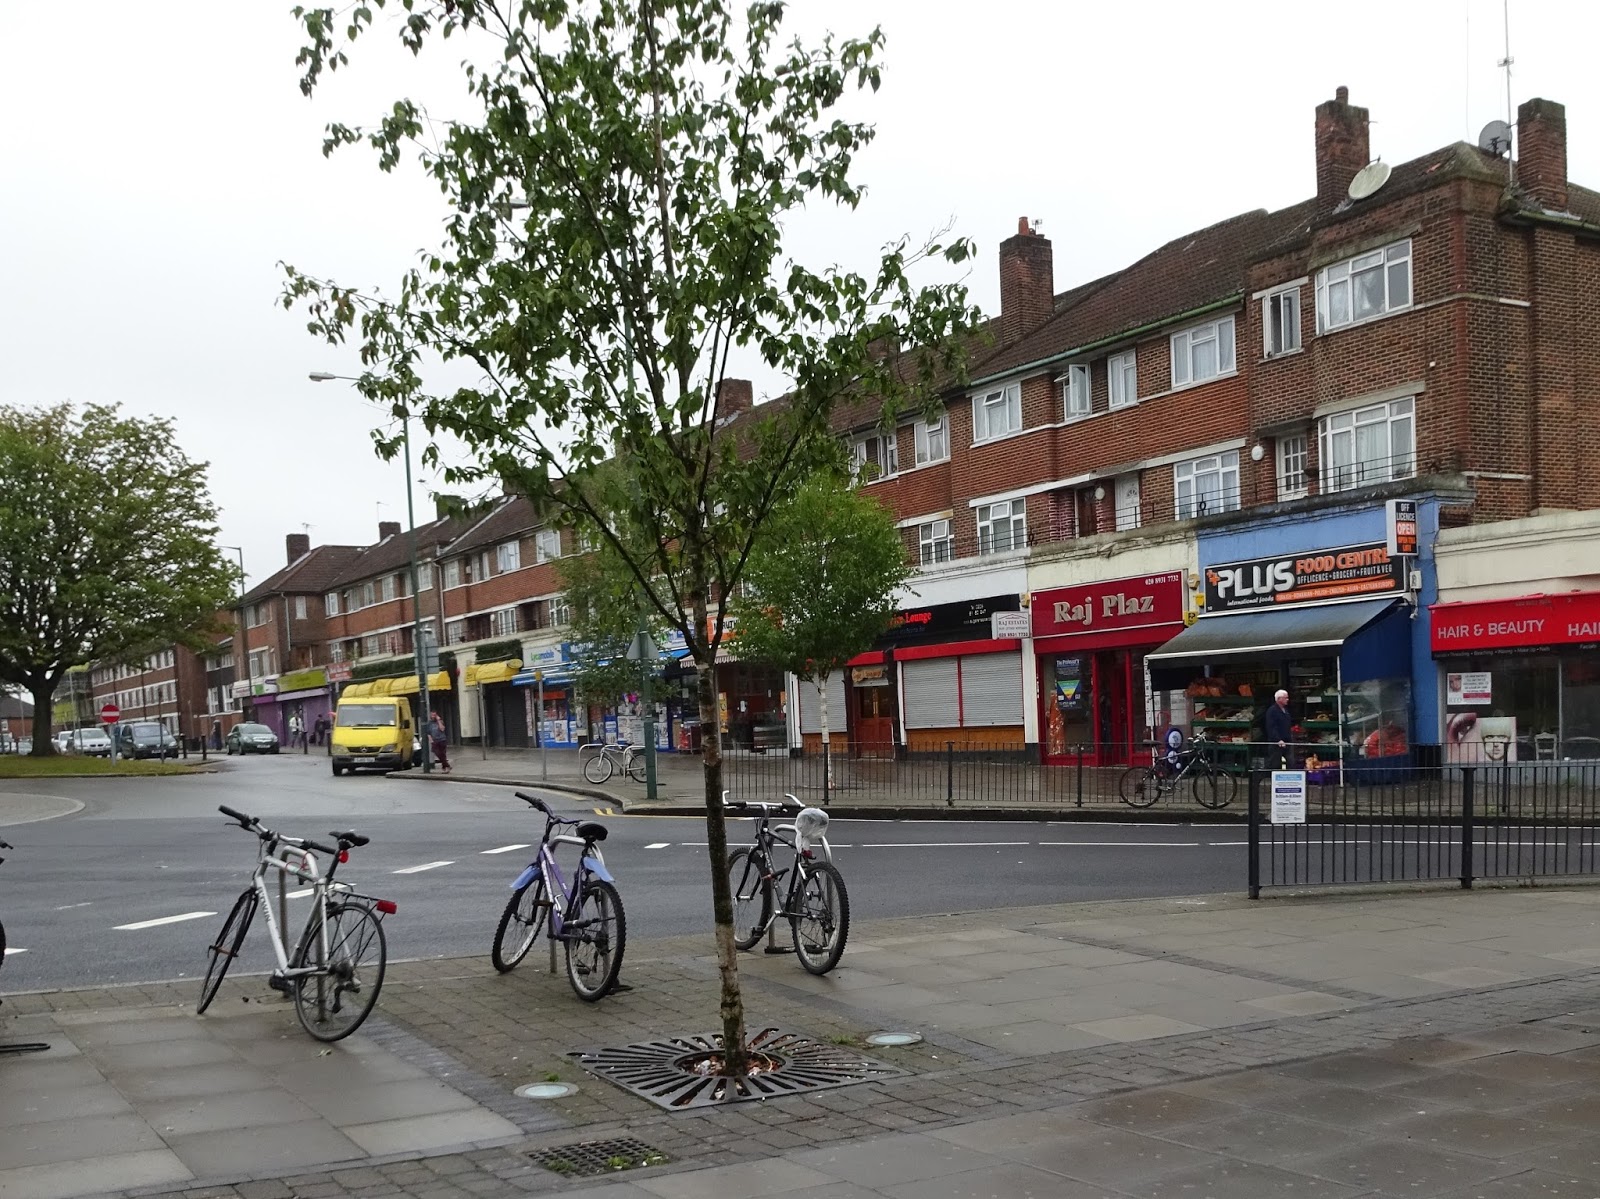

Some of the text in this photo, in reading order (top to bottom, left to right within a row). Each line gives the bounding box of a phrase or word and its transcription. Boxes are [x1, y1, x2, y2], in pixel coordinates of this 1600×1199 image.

[1400, 503, 1410, 512] OFF
[1396, 512, 1415, 521] LICENCE
[1397, 522, 1415, 536] OPEN
[1296, 548, 1390, 575] FOOD CENTRE
[1217, 560, 1296, 599] PLUS
[1332, 568, 1356, 580] GROCERY
[1053, 592, 1154, 625] Raj Plaz
[905, 612, 932, 624] Lounge
[1438, 619, 1545, 639] HAIR & BEAUTY
[1567, 622, 1600, 637] HAI
